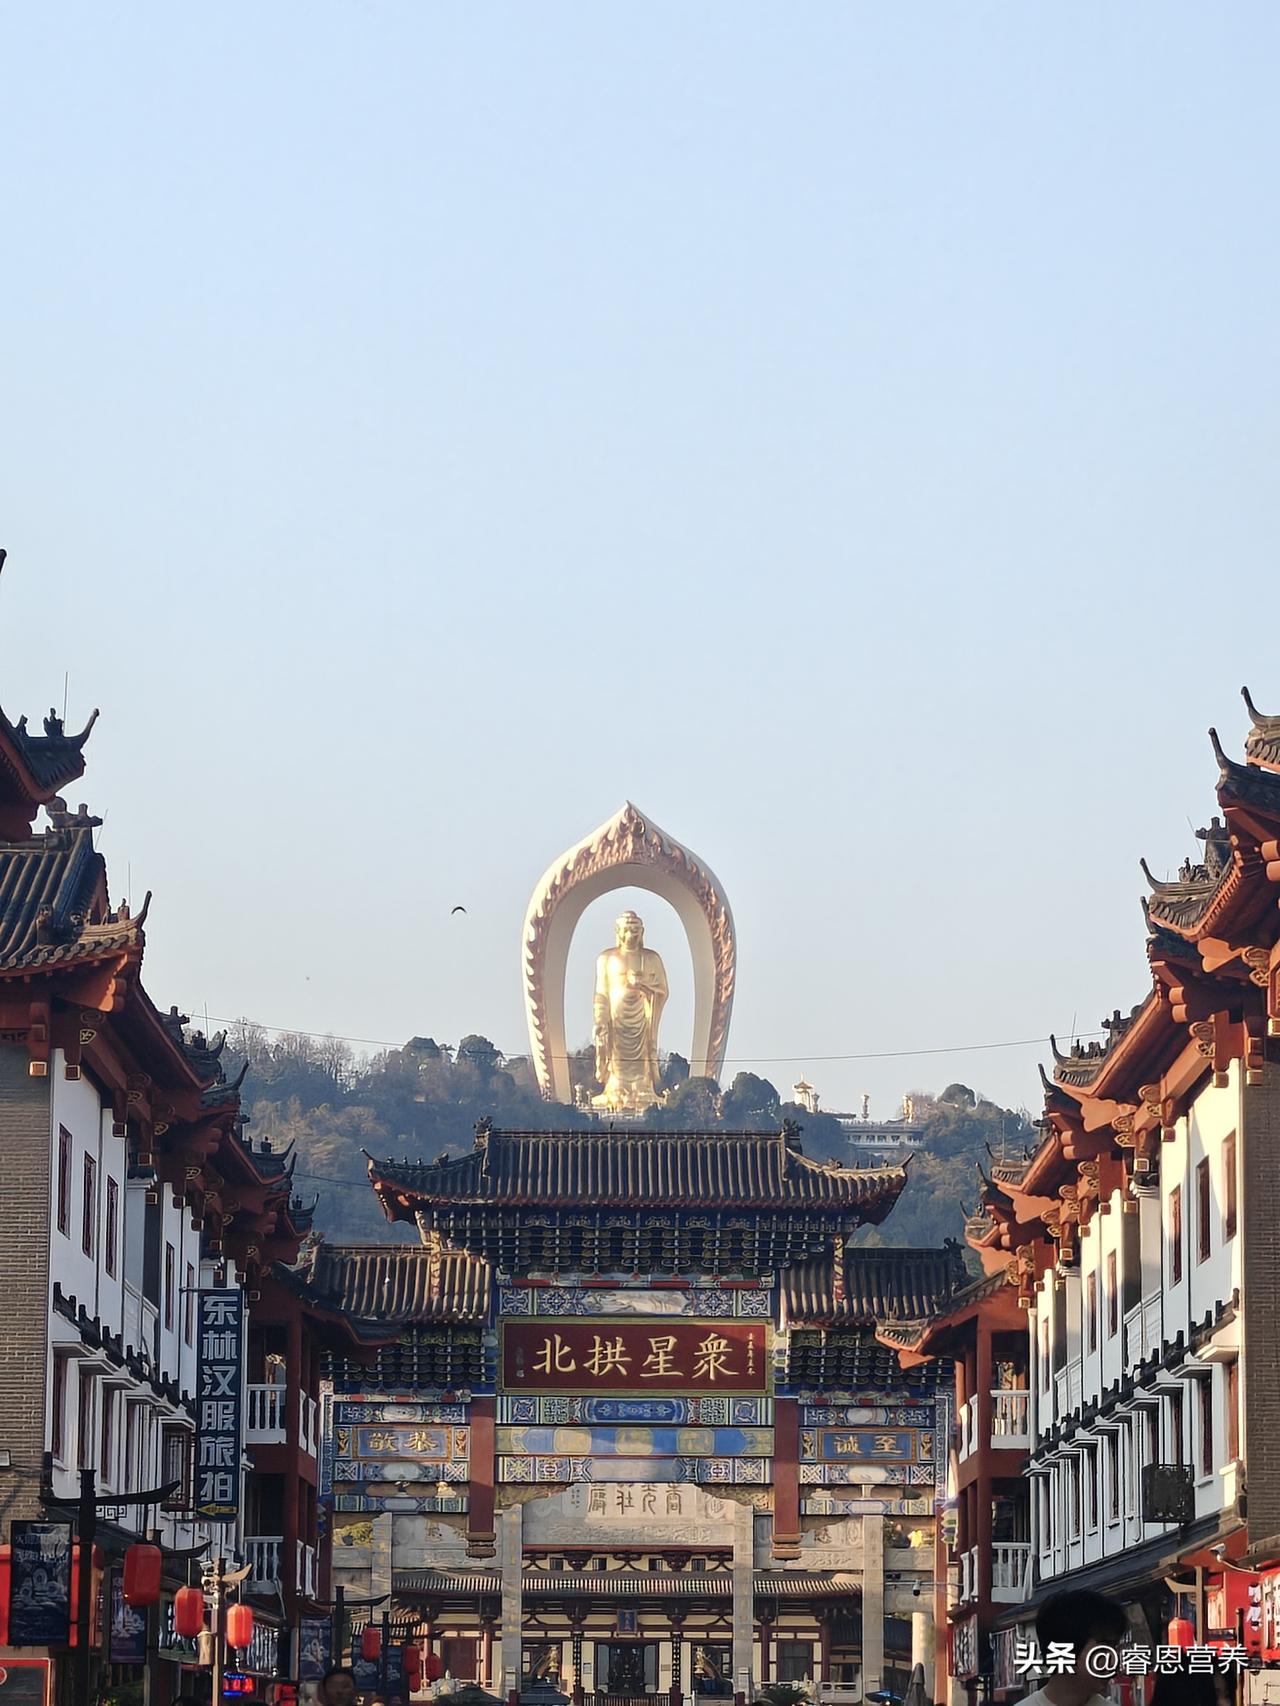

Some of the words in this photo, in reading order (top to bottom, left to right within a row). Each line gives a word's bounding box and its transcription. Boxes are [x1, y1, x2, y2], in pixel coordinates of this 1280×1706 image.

[200, 1295, 238, 1502] 东林汉服旅拍
